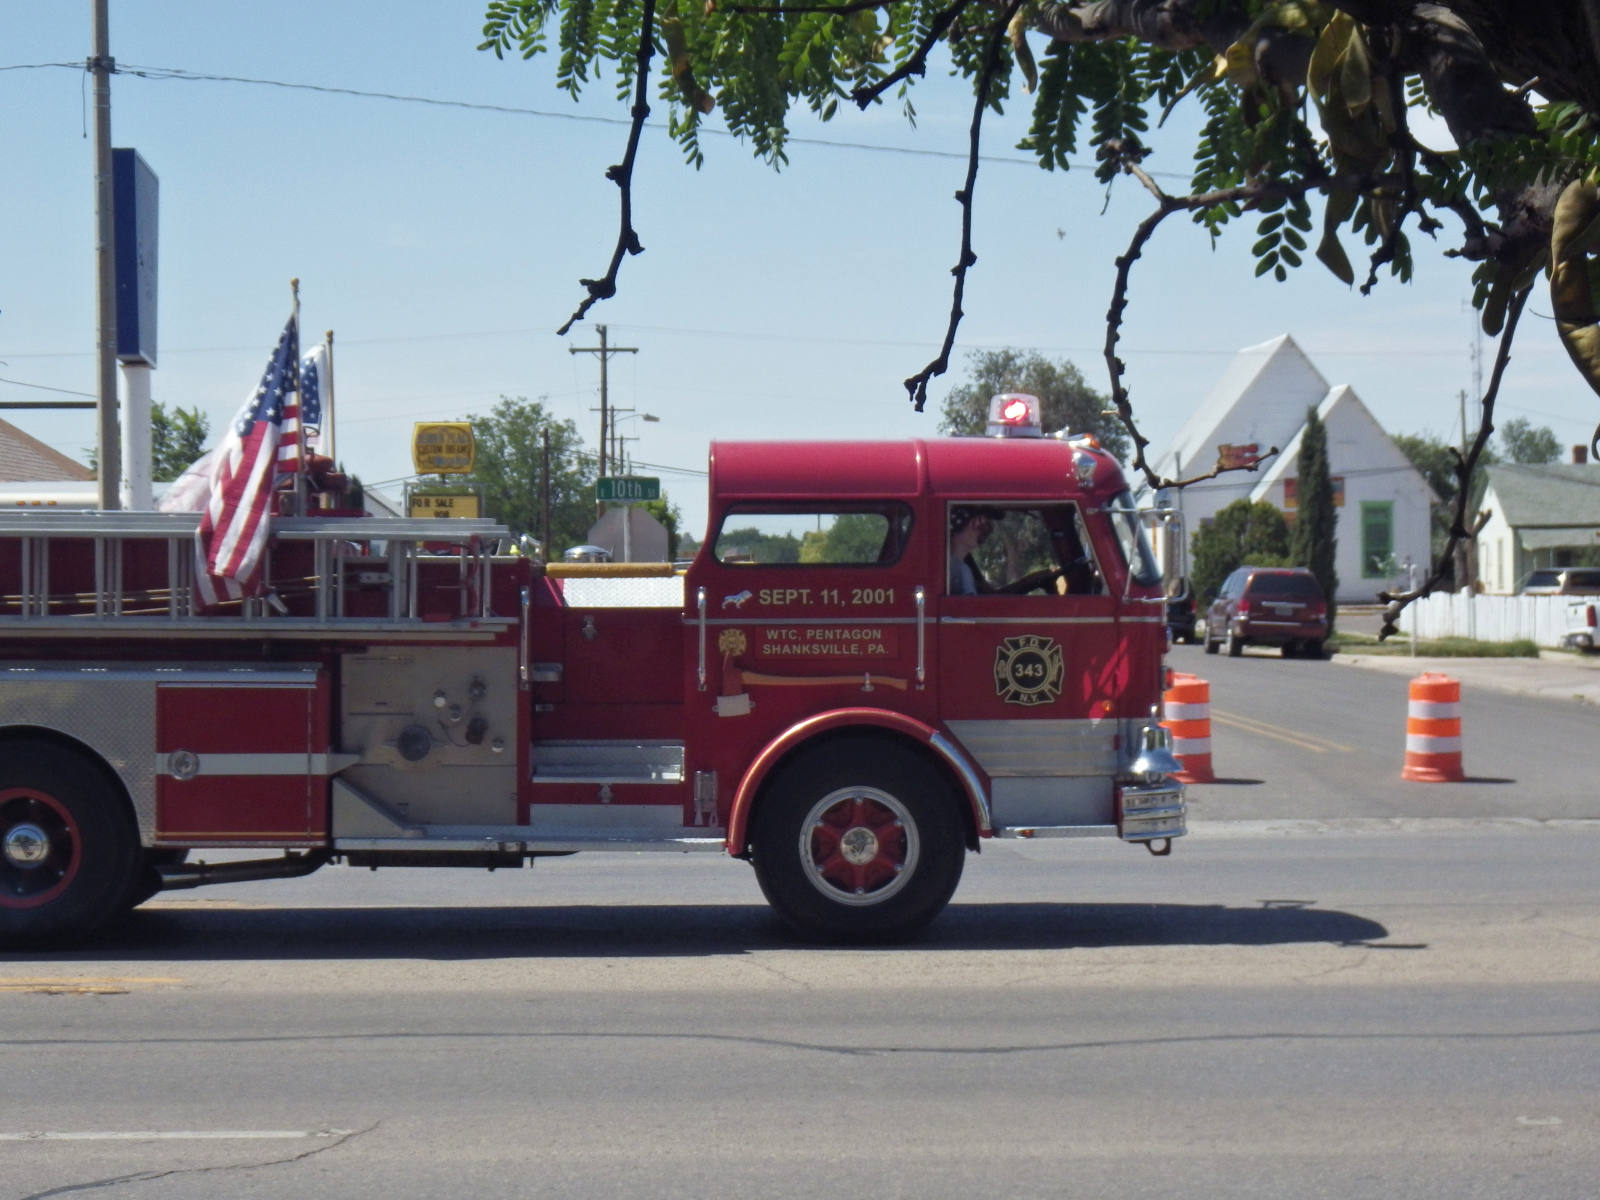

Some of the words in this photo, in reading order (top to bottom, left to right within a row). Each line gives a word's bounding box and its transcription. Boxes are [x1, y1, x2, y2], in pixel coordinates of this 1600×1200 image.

[435, 498, 455, 508] SALE
[759, 588, 814, 605] SEPT.
[820, 588, 846, 607] 11,
[851, 588, 895, 604] 2001
[806, 629, 882, 640] PENTAGON
[1015, 663, 1043, 677] 343
